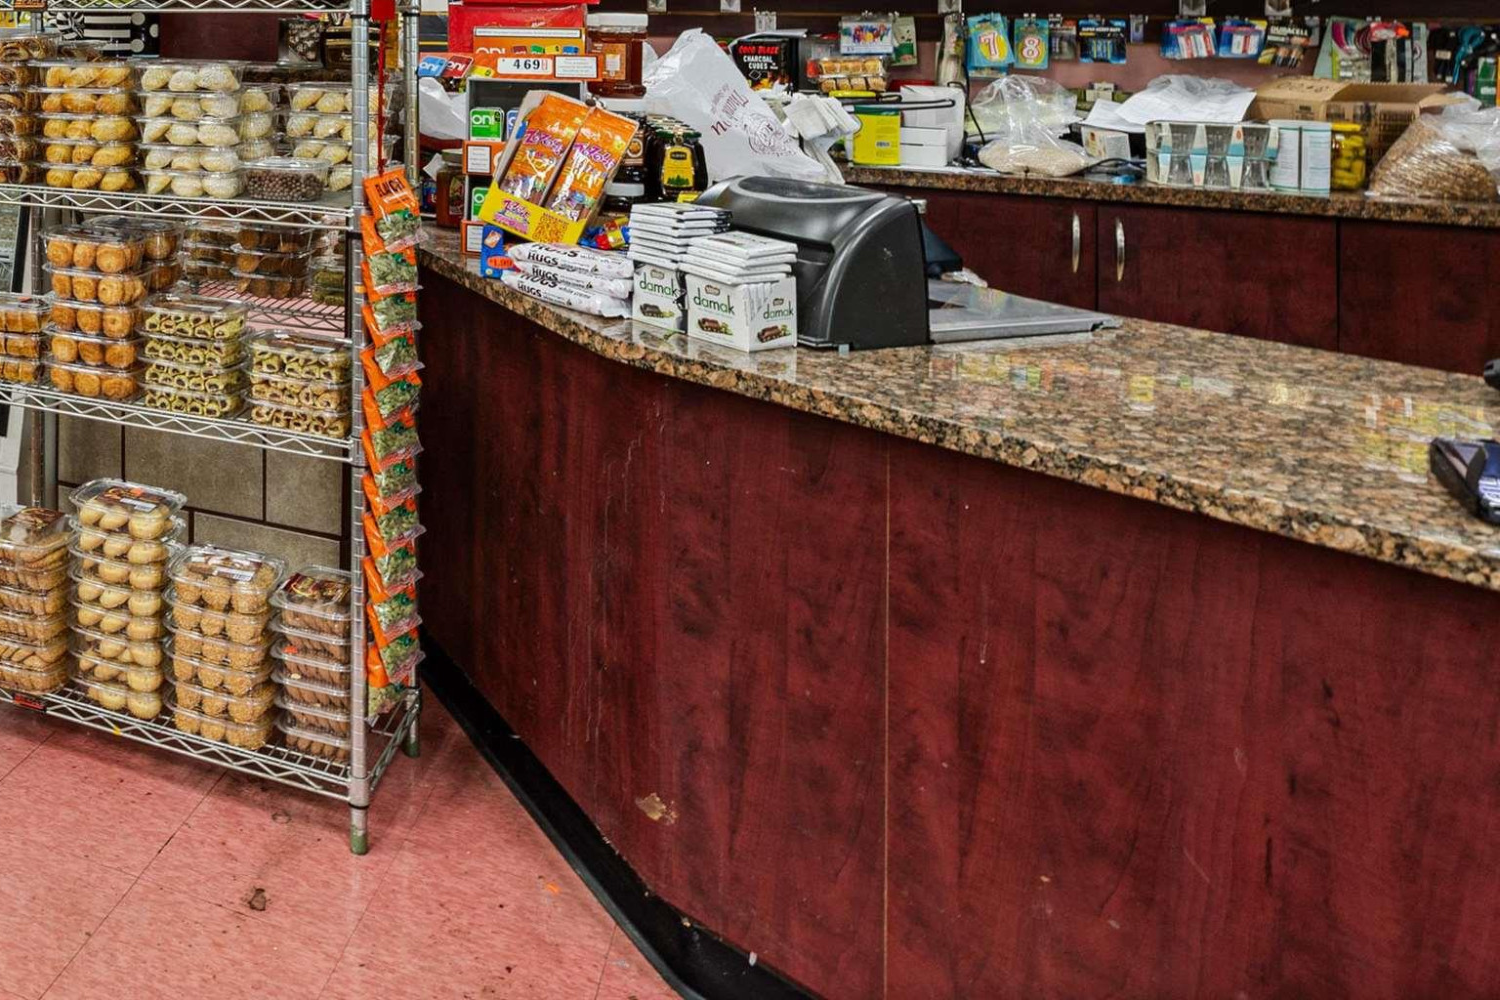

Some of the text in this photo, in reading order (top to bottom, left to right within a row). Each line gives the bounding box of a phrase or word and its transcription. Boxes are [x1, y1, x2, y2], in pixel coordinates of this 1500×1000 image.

[1270, 26, 1308, 36] DURACELL
[978, 31, 1000, 60] 7
[1022, 36, 1041, 60] 8
[743, 55, 773, 63] CHARCOAL
[748, 62, 768, 70] CUBES
[527, 252, 559, 266] HUGS
[532, 268, 559, 282] HUGS
[517, 282, 542, 298] HUGS
[639, 271, 677, 298] damak
[693, 287, 735, 316] damak
[763, 300, 794, 320] damak
